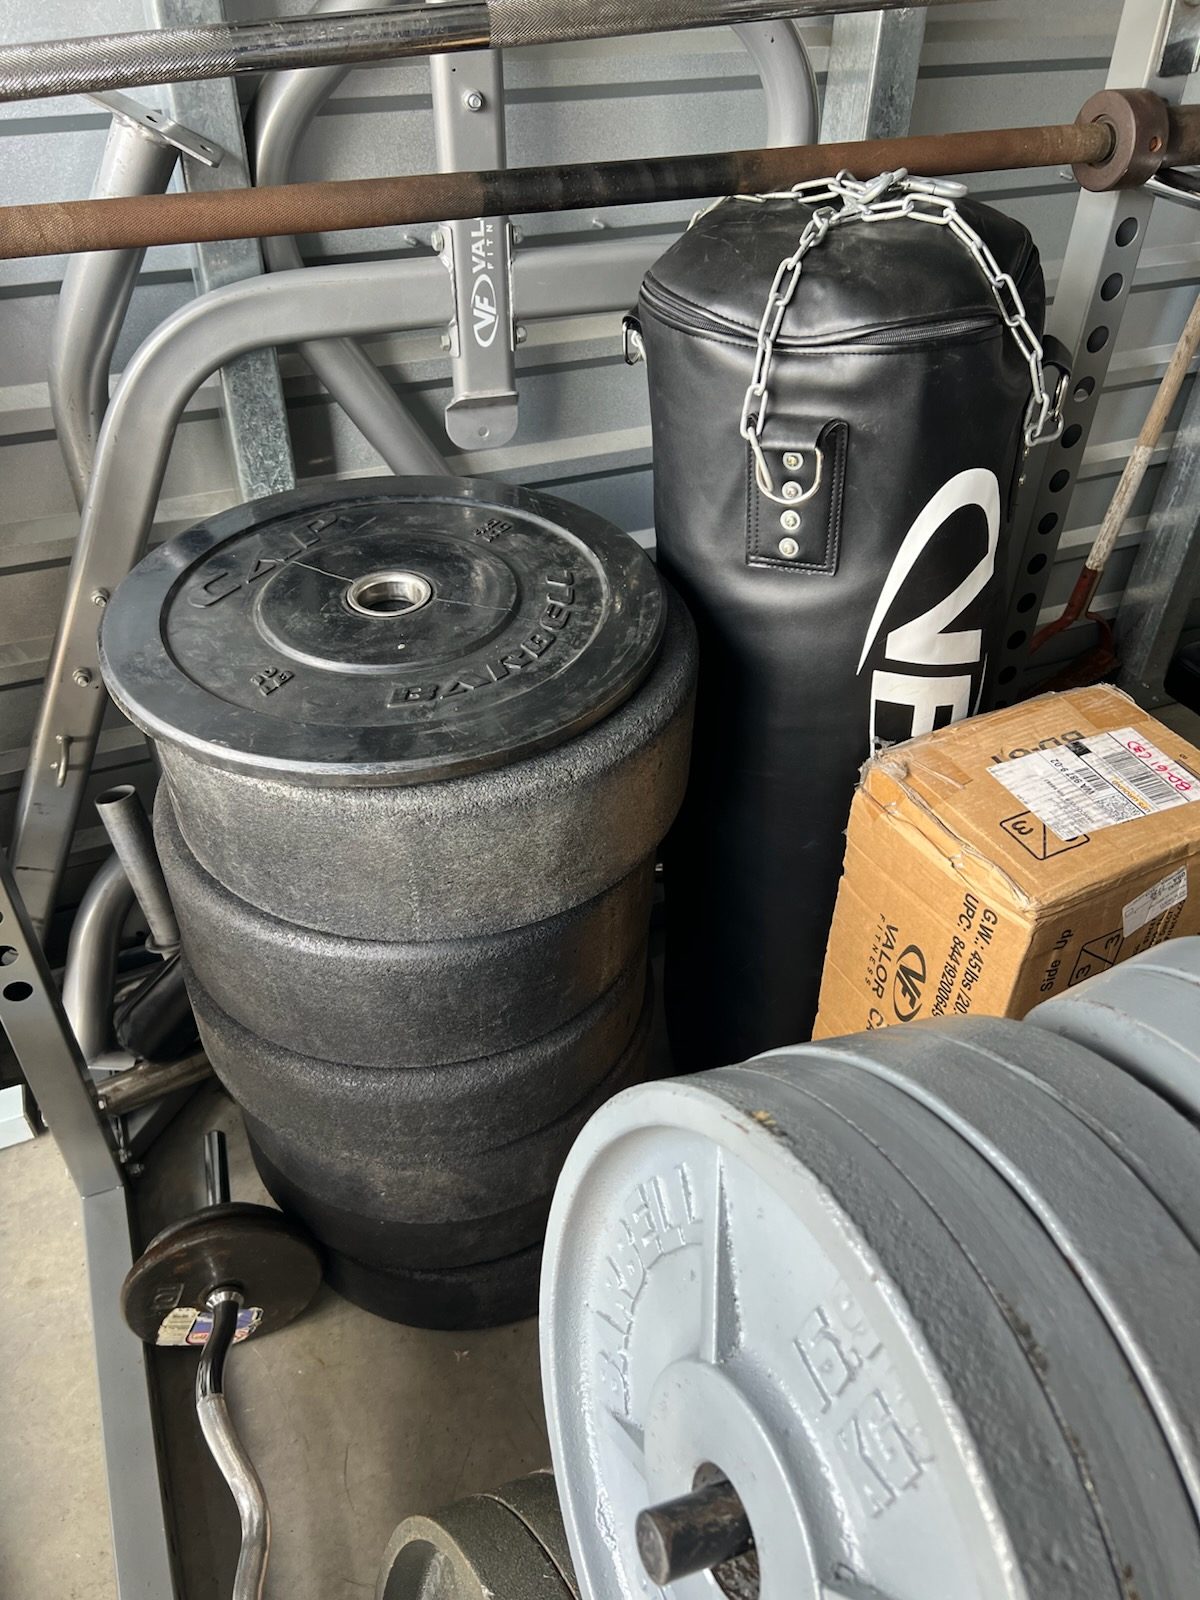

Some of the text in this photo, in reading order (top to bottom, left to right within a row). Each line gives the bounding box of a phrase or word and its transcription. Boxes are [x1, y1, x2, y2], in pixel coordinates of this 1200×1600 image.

[471, 218, 486, 273] VAL
[192, 510, 342, 609] CAP
[387, 569, 575, 709] BARBELL
[1012, 820, 1034, 835] 3
[957, 892, 979, 932] UPC:
[865, 912, 886, 986] FITNESS
[871, 924, 900, 999] VALOR
[1040, 955, 1061, 993] Side
